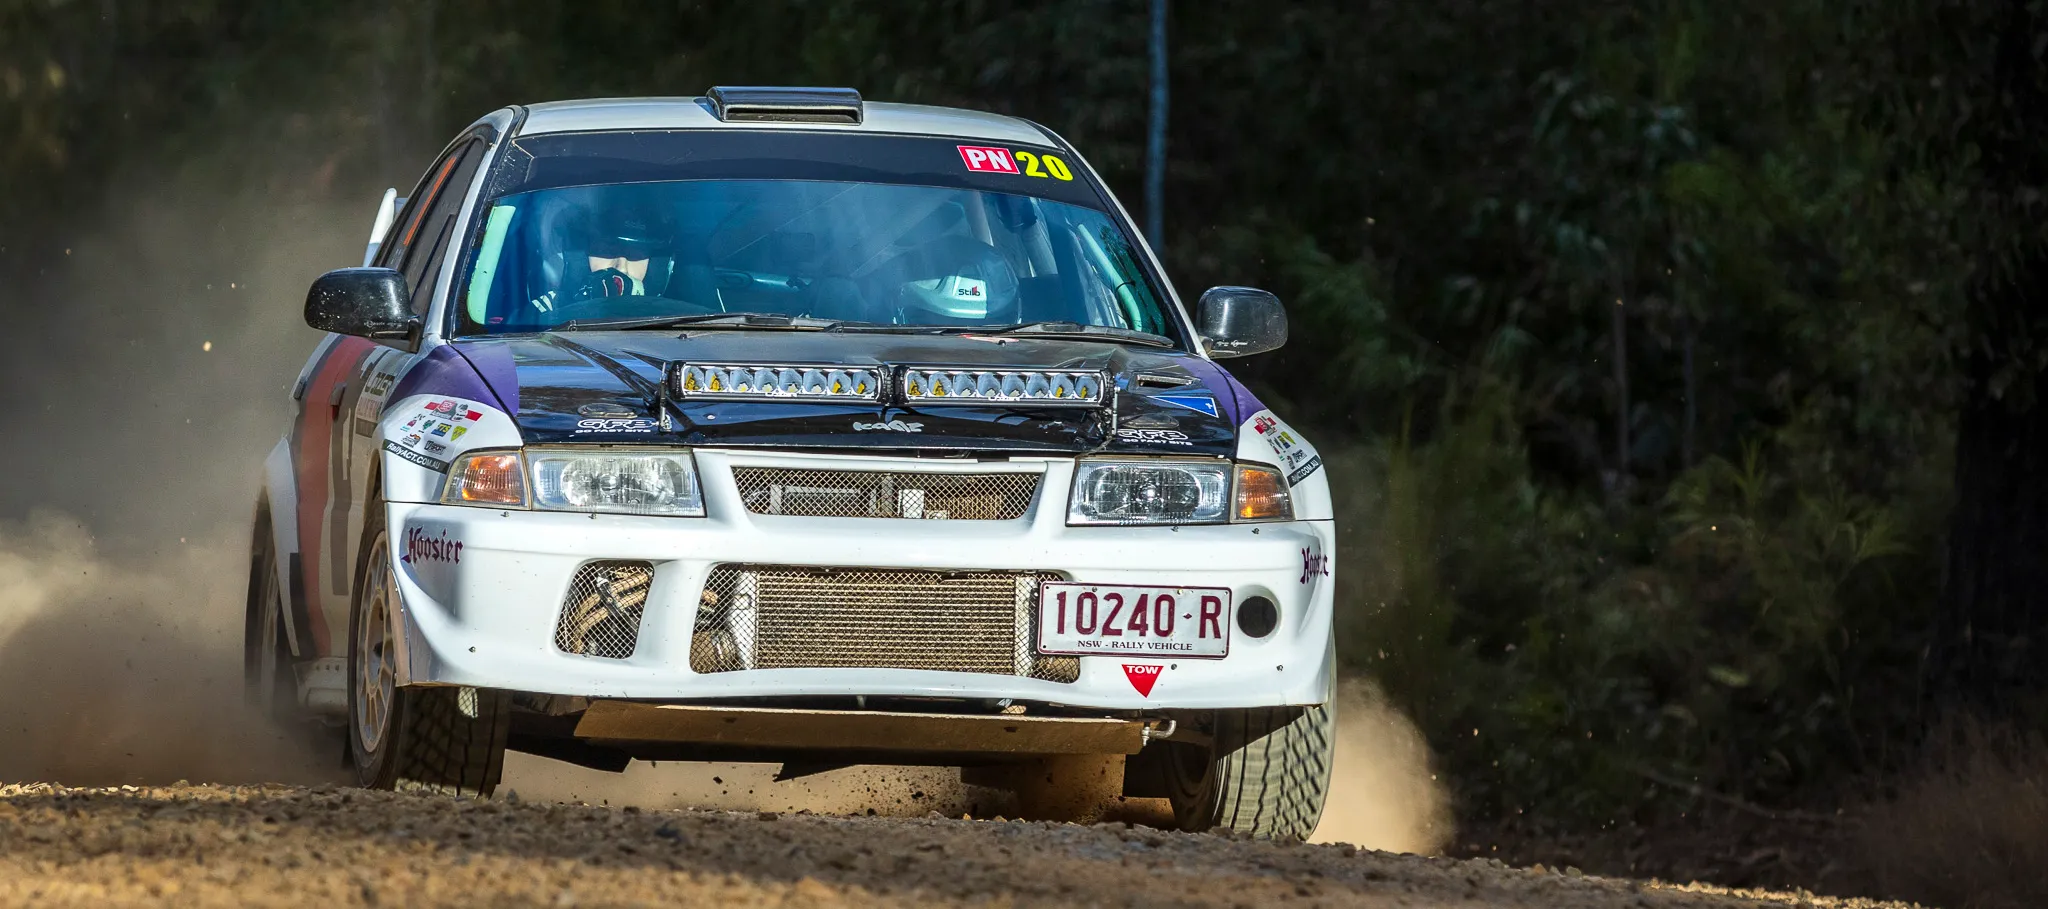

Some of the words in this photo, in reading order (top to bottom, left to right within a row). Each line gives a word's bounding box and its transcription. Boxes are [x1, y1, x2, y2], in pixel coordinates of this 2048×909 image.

[964, 148, 1013, 171] PN
[1015, 151, 1074, 181] 20
[958, 286, 981, 297] Stilo
[401, 525, 464, 564] Hoosier
[1299, 544, 1329, 585] Hoosir
[1077, 640, 1103, 648] NSW
[1111, 640, 1145, 649] RALLY
[1147, 641, 1193, 651] VEHICLE
[1126, 665, 1159, 675] TOW
